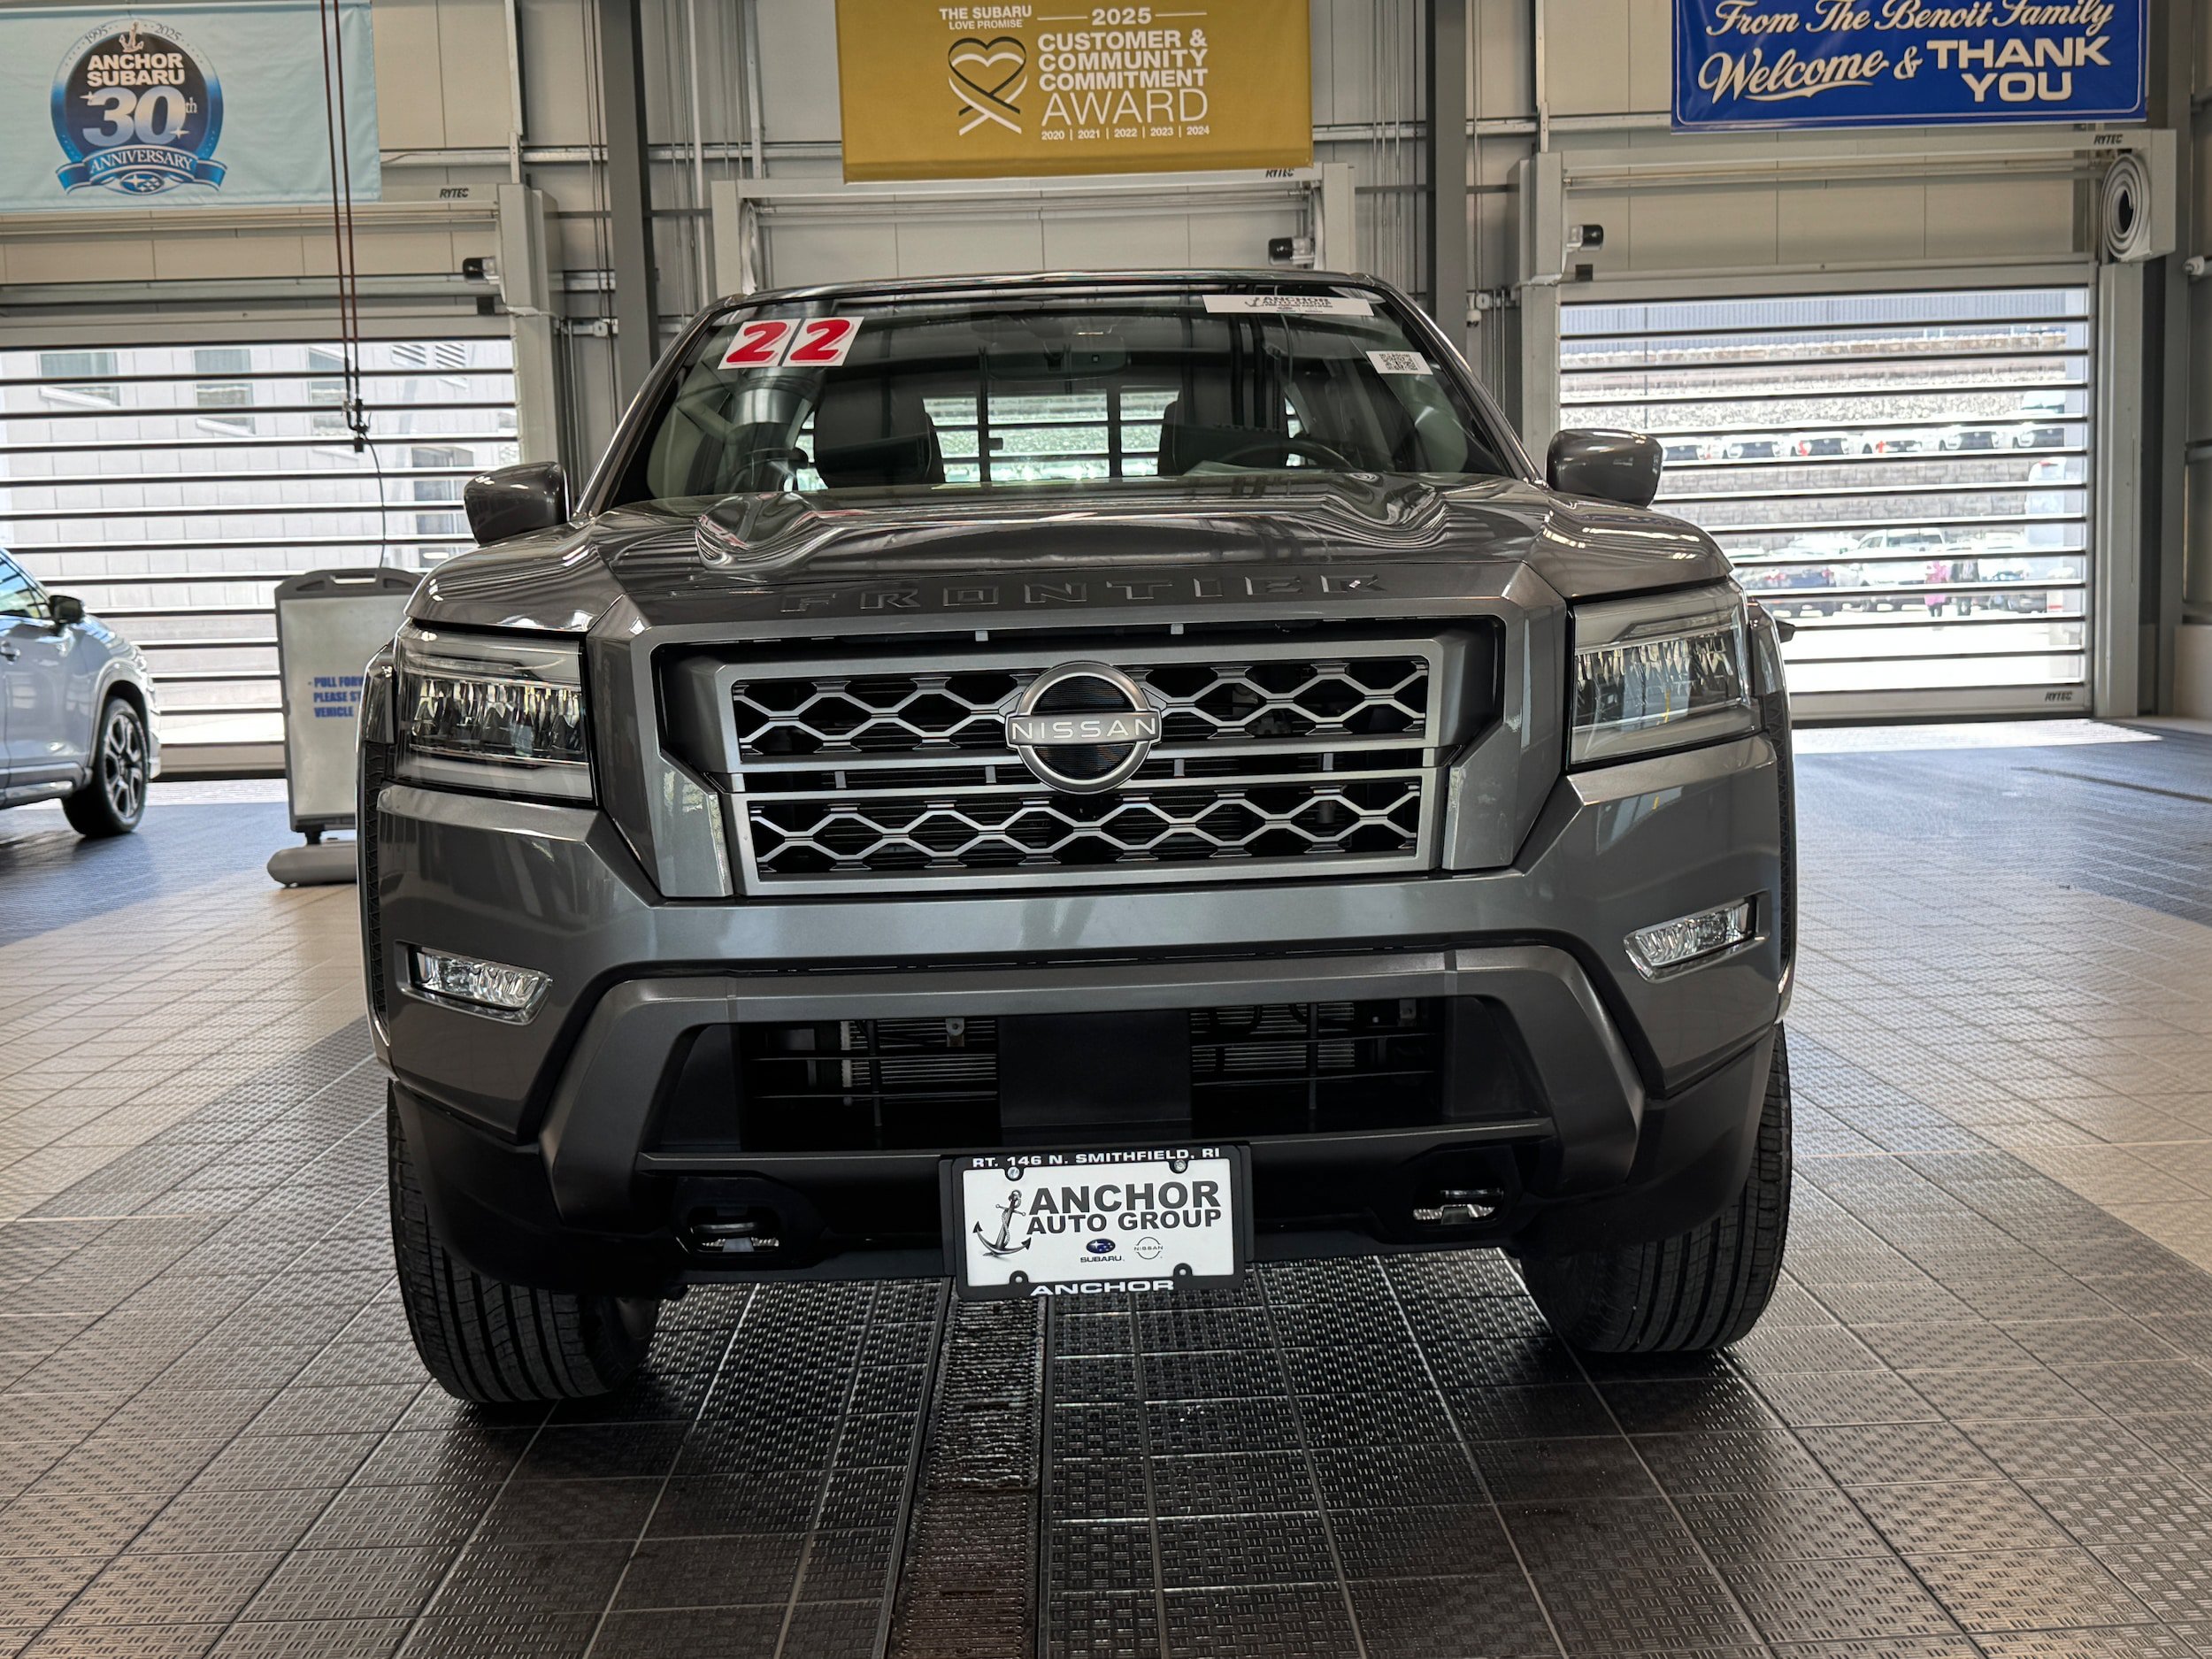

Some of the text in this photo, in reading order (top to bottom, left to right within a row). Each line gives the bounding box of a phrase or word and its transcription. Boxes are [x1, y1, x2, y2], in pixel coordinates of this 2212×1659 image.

[939, 5, 1032, 20] THE SUBARU
[1092, 7, 1152, 26] 2025
[1706, 0, 2115, 36] From The Benoit Family
[155, 23, 182, 41] 2025
[949, 19, 1023, 30] LOVE PROMISE
[85, 26, 109, 44] 1995
[1037, 28, 1208, 51] CUSTOMER &
[87, 53, 184, 70] ANCHOR
[1038, 49, 1209, 72] COMMUNITY
[1698, 36, 2111, 104] Welcome & THANK
[87, 69, 186, 87] SUBARU
[1039, 69, 1209, 92] COMMITMENT
[1961, 72, 2072, 103] YOU
[1041, 88, 1209, 127] AWARD
[1041, 126, 1210, 141] 2020 2021 2022 2023 2024
[2093, 134, 2124, 145] RYTEC
[89, 149, 193, 174] ANNIVERSARY
[439, 188, 469, 198] RYTEC
[780, 573, 1386, 612] FRONTIER
[314, 677, 337, 687] PULL
[313, 692, 348, 703] PLEASE
[314, 706, 354, 718] VEHICLE
[1011, 718, 1156, 740] NISSAN
[972, 1157, 998, 1167] RT.
[1007, 1156, 1042, 1165] 146
[1049, 1154, 1068, 1164] N.
[1202, 1148, 1220, 1158] RI
[1028, 1180, 1221, 1216] ANCHOR
[1026, 1209, 1222, 1235] AUTO GROUP
[1030, 1279, 1174, 1295] ANCHOR
